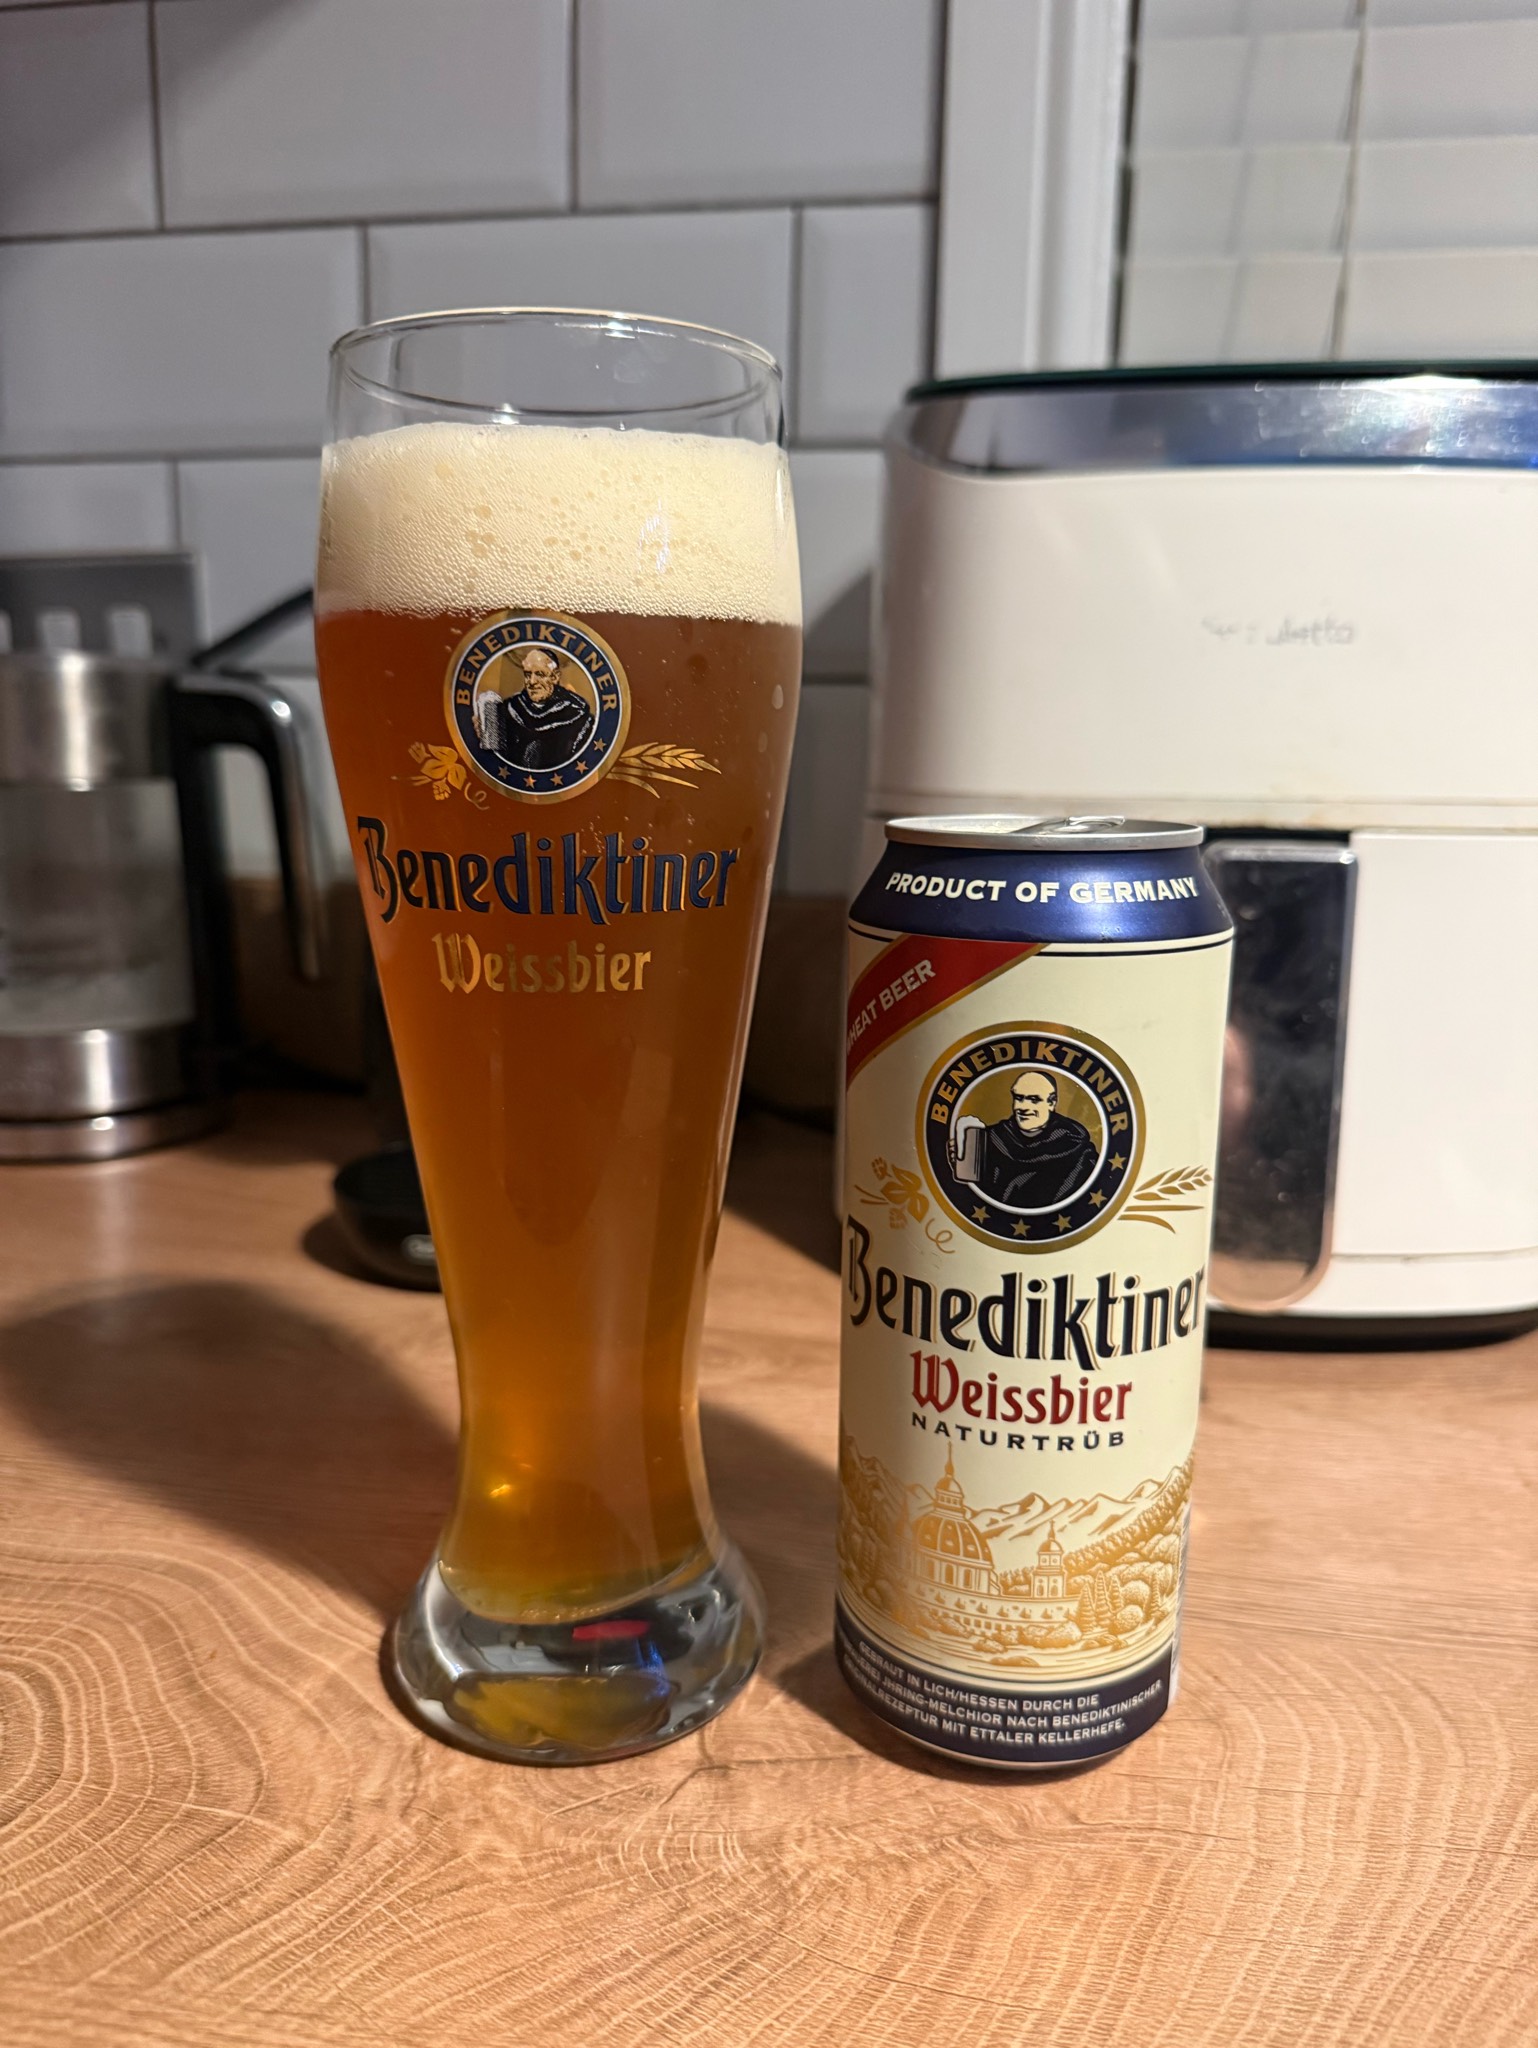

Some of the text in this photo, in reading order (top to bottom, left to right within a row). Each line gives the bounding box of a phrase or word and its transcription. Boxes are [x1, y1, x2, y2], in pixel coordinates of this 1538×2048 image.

[456, 623, 618, 711] BENEDIKTINER
[357, 815, 741, 926] Benediktiner
[885, 871, 1199, 904] PRODUCT OF GERMANY
[431, 932, 652, 995] Weissbier
[878, 959, 936, 1012] BEER
[930, 1039, 1129, 1135] BENEDIKTINER
[847, 1214, 1205, 1372] Benediktiner
[910, 1349, 1132, 1426] Weissbier
[911, 1411, 1125, 1452] NATURTRÜB
[843, 1652, 939, 1728] GINALREZEPTUR
[941, 1720, 967, 1736] MIT
[970, 1726, 1034, 1744] ETTALER
[1037, 1718, 1126, 1744] KELLERHEFE.
[907, 1672, 920, 1688] IN
[923, 1679, 1018, 1711] LICH/HESSEN
[1022, 1698, 1073, 1712] DURCH
[1077, 1693, 1099, 1708] DIE
[1006, 1714, 1049, 1728] NACH
[1052, 1678, 1163, 1726] BENEDIKTINISCHER
